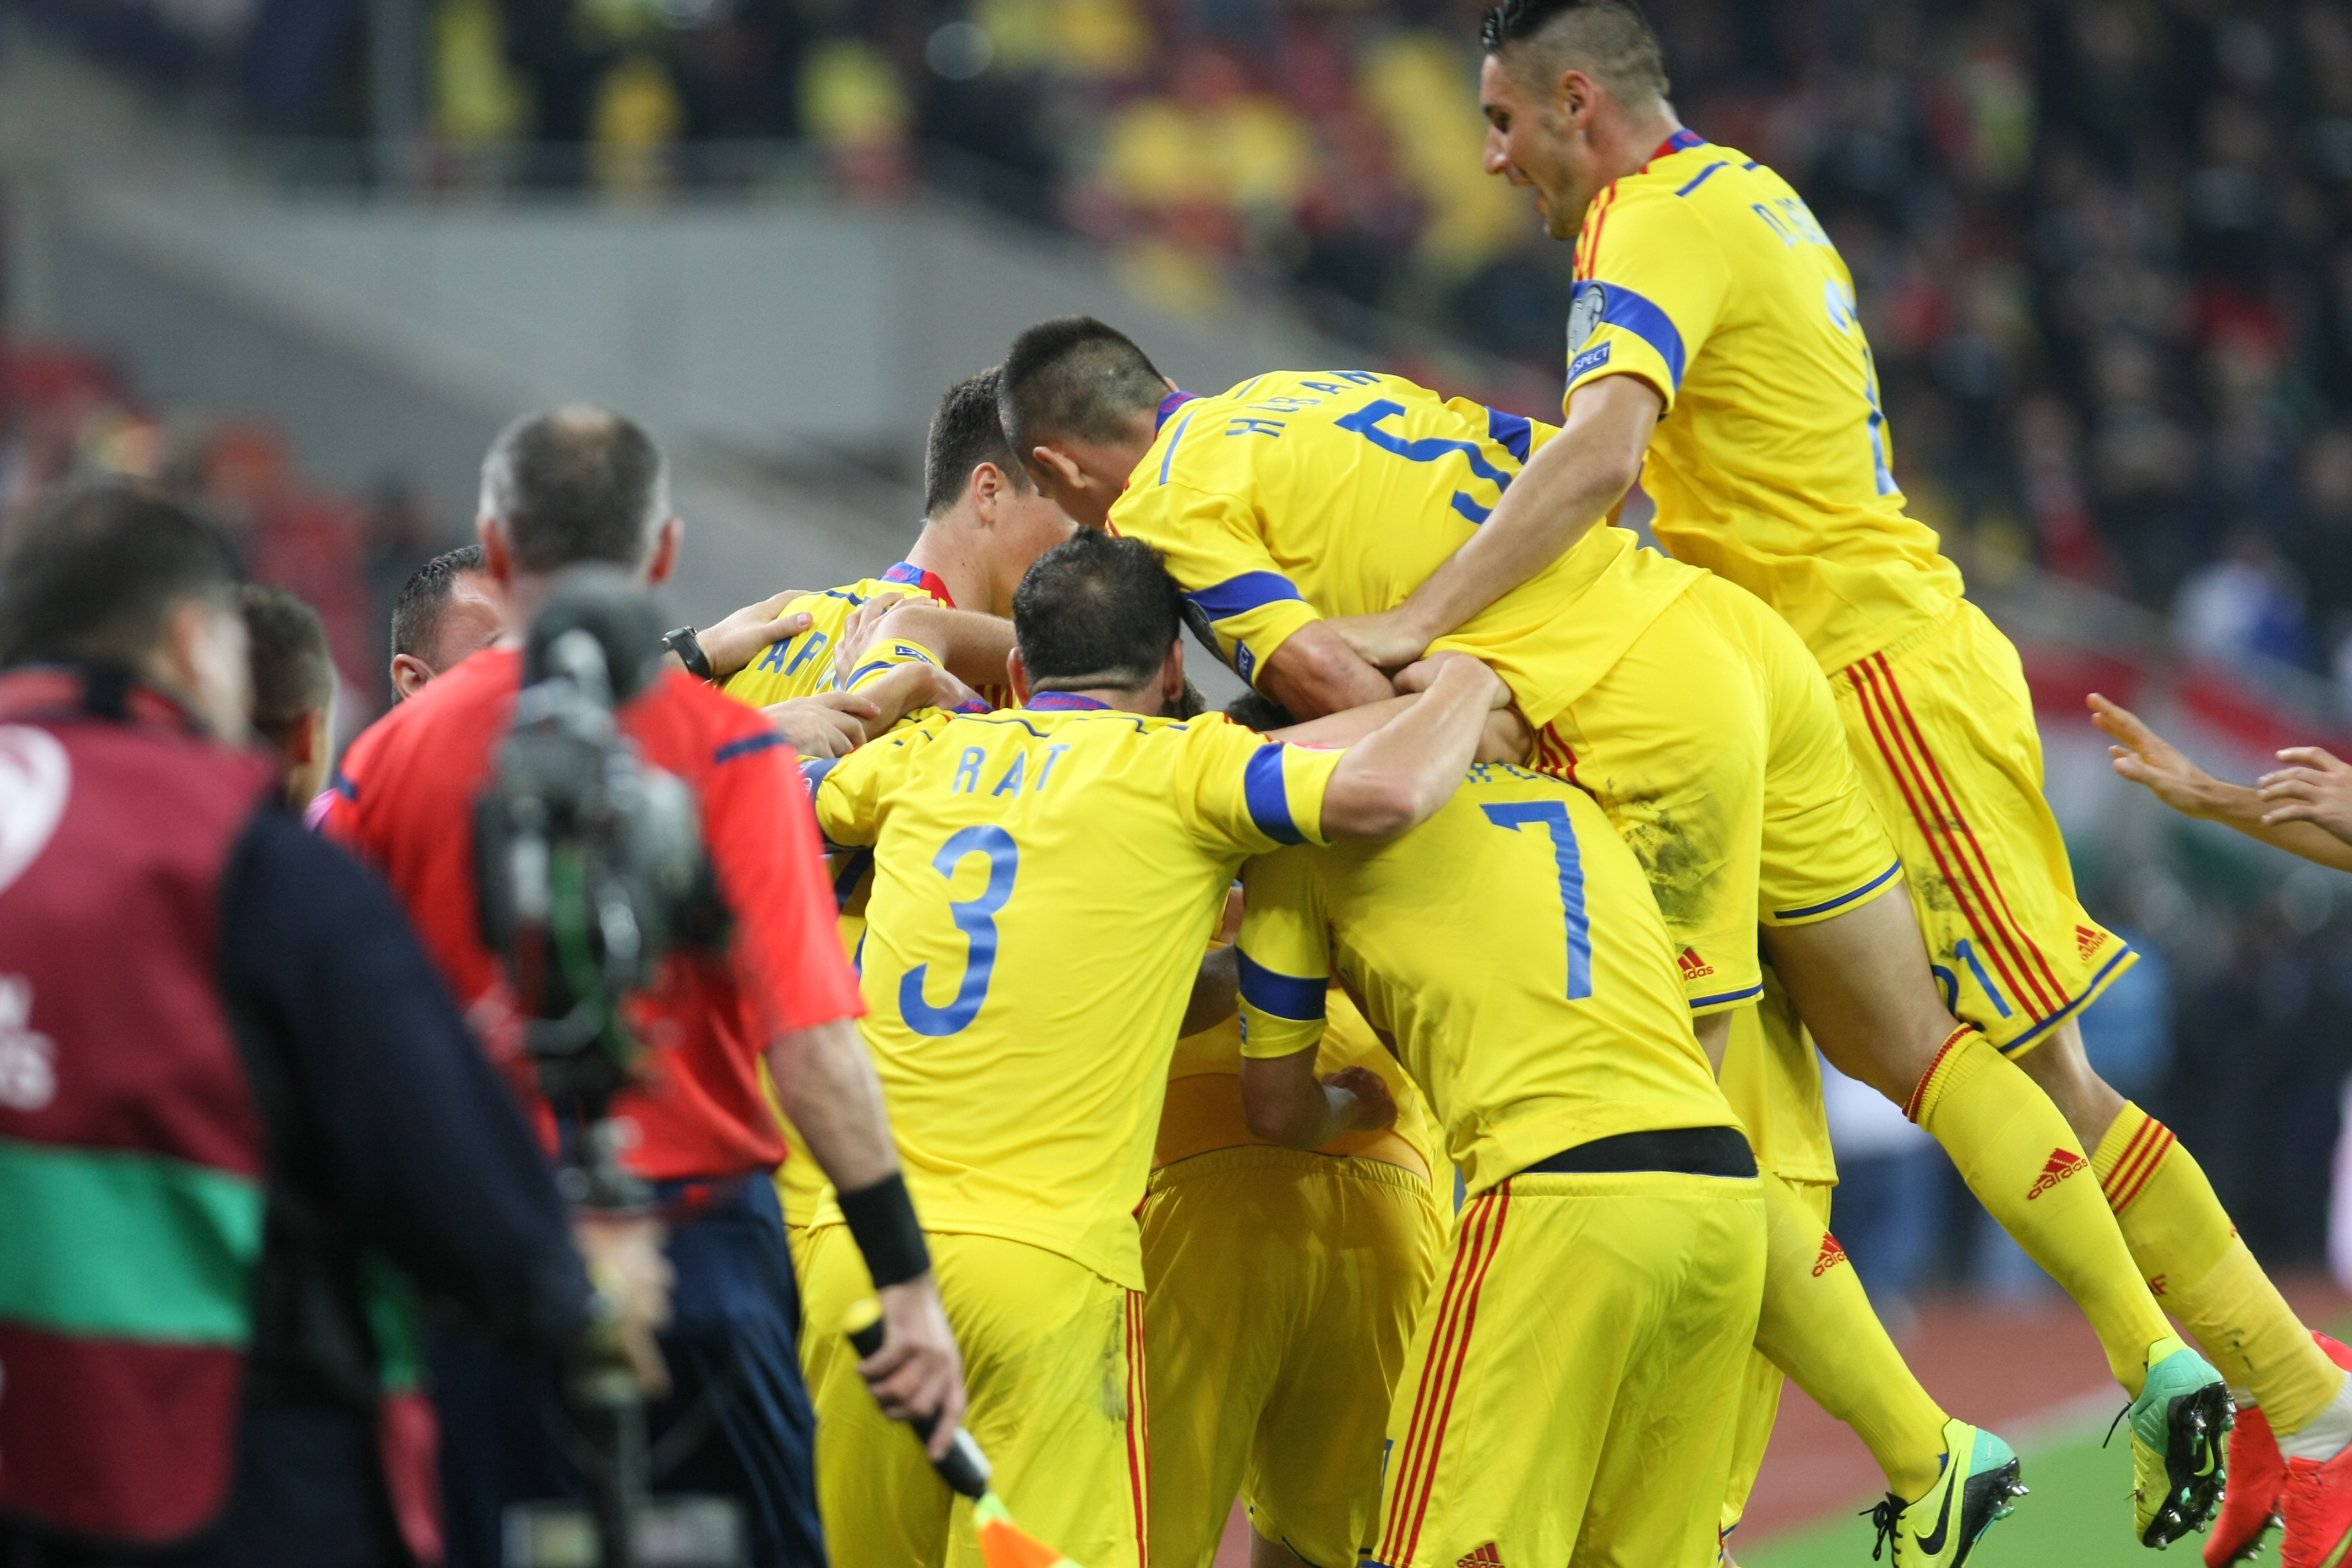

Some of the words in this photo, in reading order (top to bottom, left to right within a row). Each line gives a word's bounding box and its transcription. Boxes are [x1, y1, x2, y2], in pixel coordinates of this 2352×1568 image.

[1333, 398, 1513, 525] 5
[952, 746, 1071, 798] RAT
[1479, 800, 1592, 1000] 7
[898, 824, 1019, 1036] 3
[2081, 932, 2108, 962] adidas
[1683, 966, 1715, 981] idas
[2027, 1158, 2089, 1200] adidas
[1812, 1250, 1848, 1277] adid
